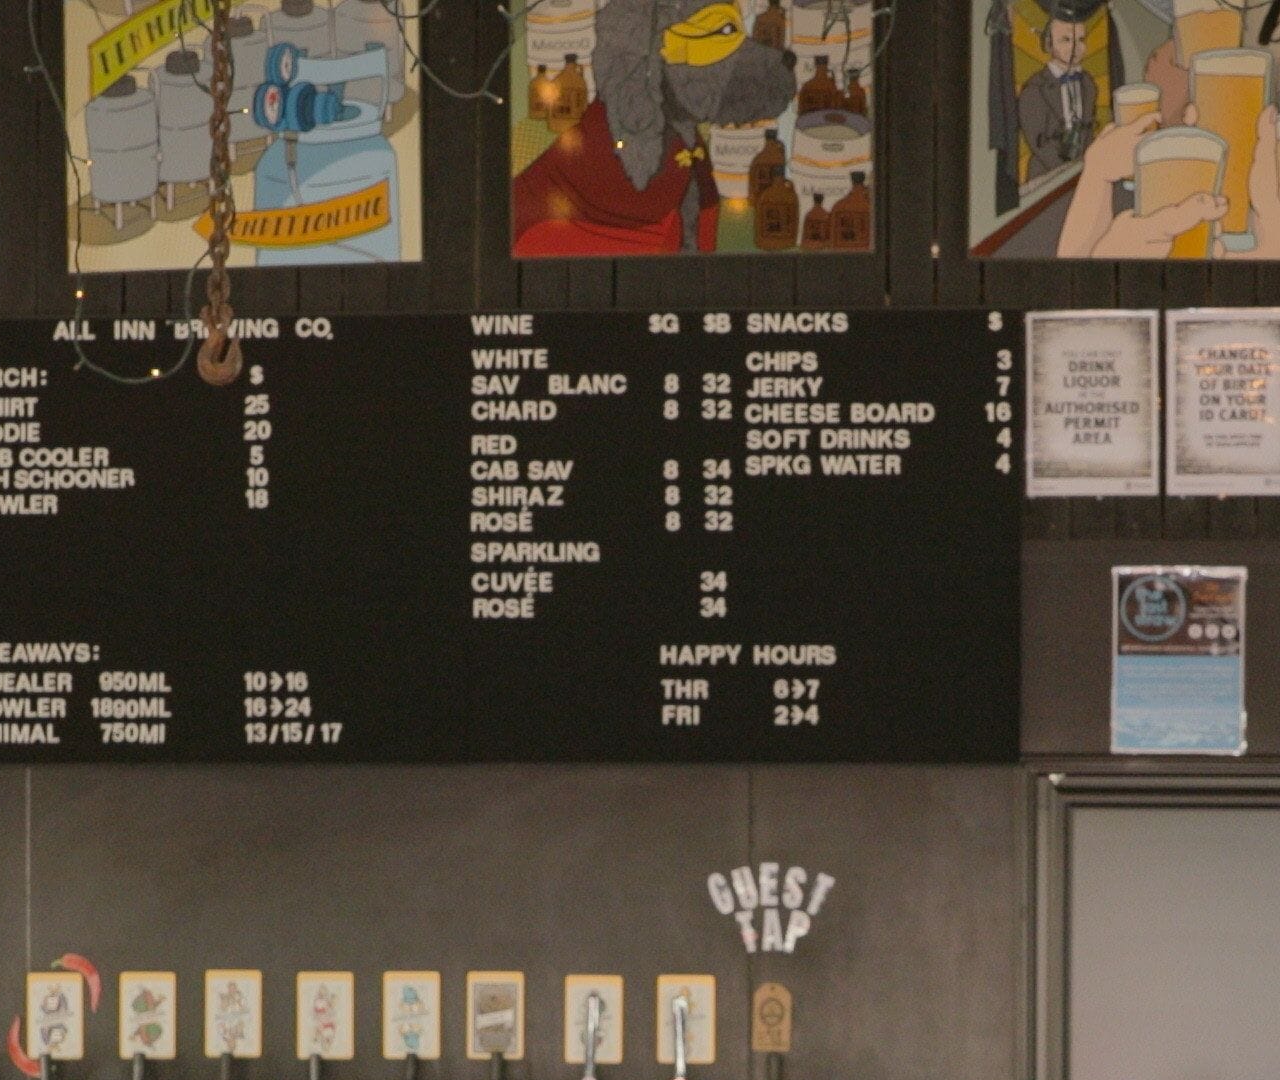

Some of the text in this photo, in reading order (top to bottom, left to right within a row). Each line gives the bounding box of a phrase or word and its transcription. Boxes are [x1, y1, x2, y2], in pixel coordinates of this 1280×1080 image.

[53, 320, 96, 341] ALL
[114, 320, 155, 340] INN
[471, 314, 533, 335] WINE
[747, 312, 848, 333] SNACKS
[471, 348, 548, 369] WHITE
[746, 351, 818, 372] CHIPS
[1069, 360, 1115, 372] DRINK
[471, 374, 627, 395] SAV BLANC
[746, 377, 823, 398] JERKY
[1063, 375, 1121, 389] LIQUOR
[244, 394, 270, 415] 25
[471, 400, 557, 421] CHARD
[744, 402, 935, 424] CHEESE BOARD
[1045, 401, 1140, 414] AUTHORISED
[244, 420, 272, 440] 20
[1064, 416, 1120, 430] PERMIT
[471, 434, 517, 455] RED
[746, 429, 910, 450] SOFT DRINKS
[1072, 433, 1112, 445] AREA
[19, 447, 110, 470] COOLER
[250, 445, 264, 465] 5
[745, 454, 901, 476] SPKG WATER
[14, 466, 135, 490] SCHOONER
[470, 460, 573, 481] CAB SAV
[245, 487, 269, 509] 18
[472, 485, 563, 508] SHIRAZ
[470, 506, 532, 532] ROSÉ
[471, 542, 600, 563] SPARKLING
[471, 566, 553, 595] CUVÉE
[473, 593, 534, 618] ROSÉ
[660, 644, 836, 665] HAPPY HOURS
[99, 671, 171, 692] 950ML
[661, 679, 709, 699] THR
[91, 697, 171, 719] 1890ML
[662, 705, 700, 725] FRI
[707, 862, 835, 916] GUEST
[735, 908, 810, 954] TAP
